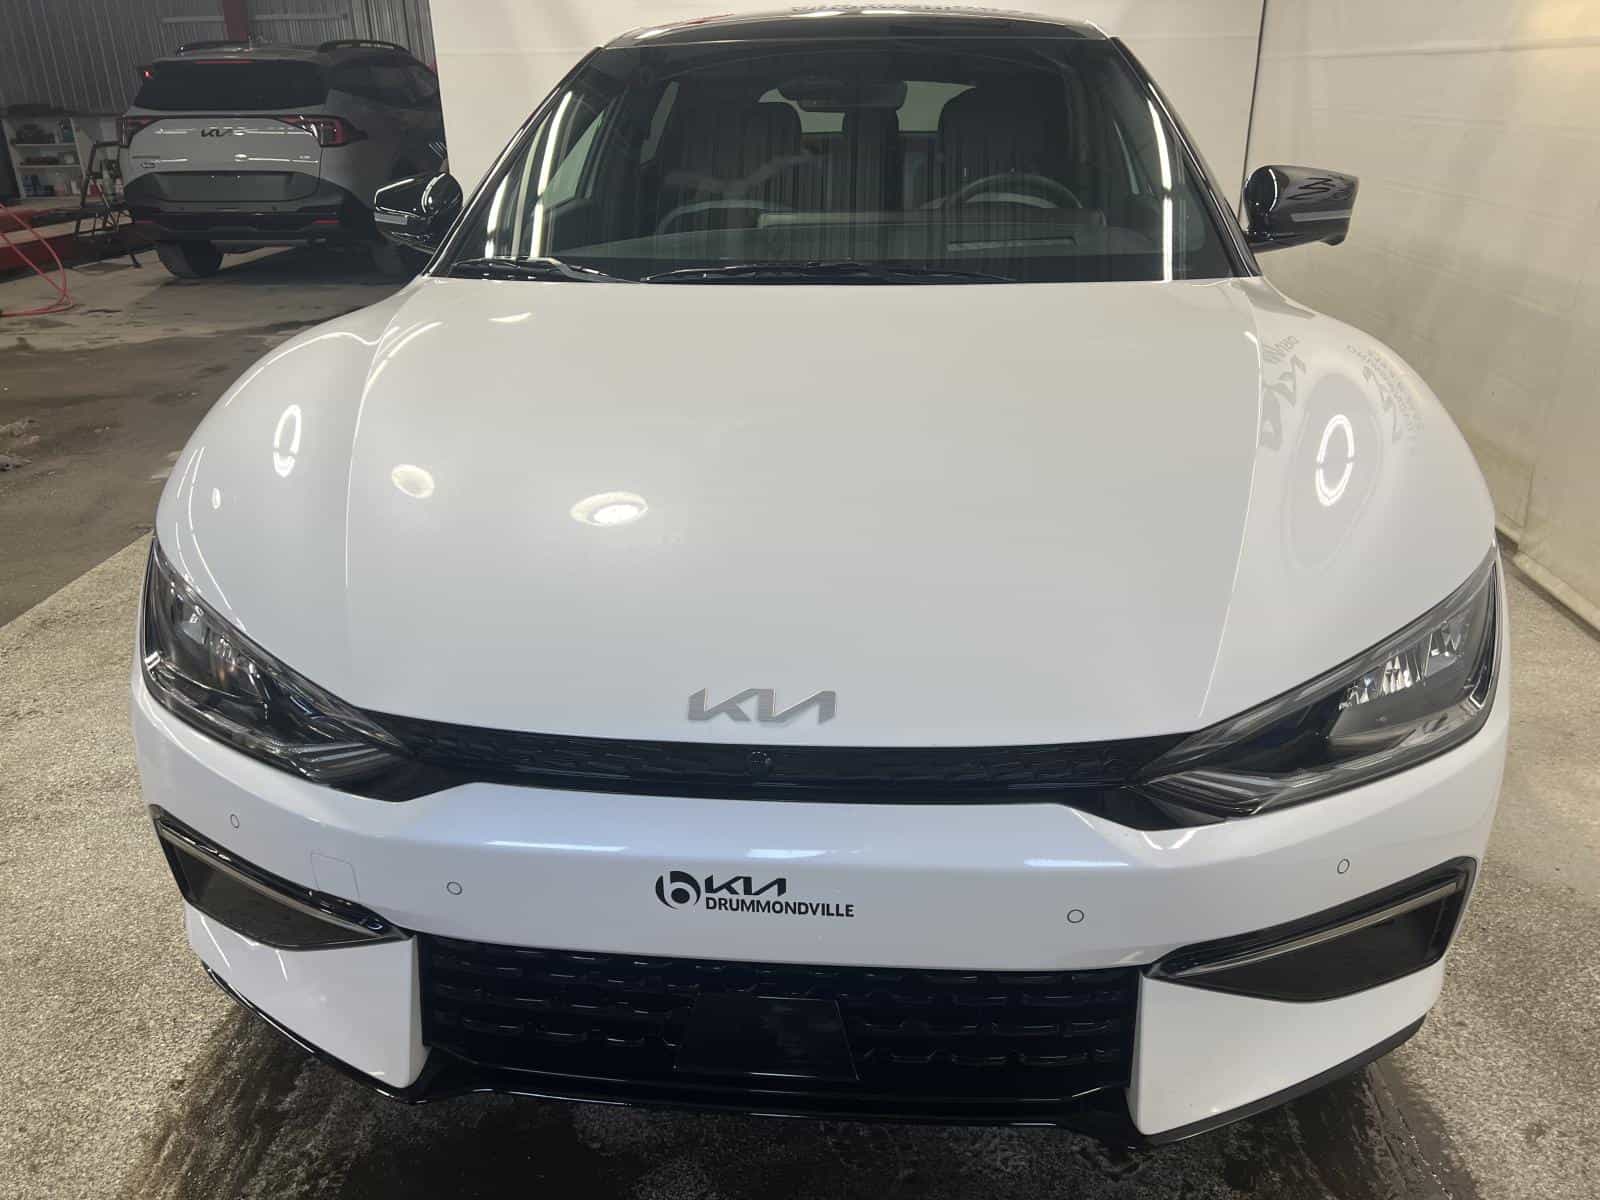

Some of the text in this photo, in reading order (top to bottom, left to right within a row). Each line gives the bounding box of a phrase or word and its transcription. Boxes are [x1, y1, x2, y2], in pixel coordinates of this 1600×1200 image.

[687, 687, 836, 725] KIA
[704, 874, 787, 897] KIA
[706, 897, 855, 918] DRUMMONDVILLE
